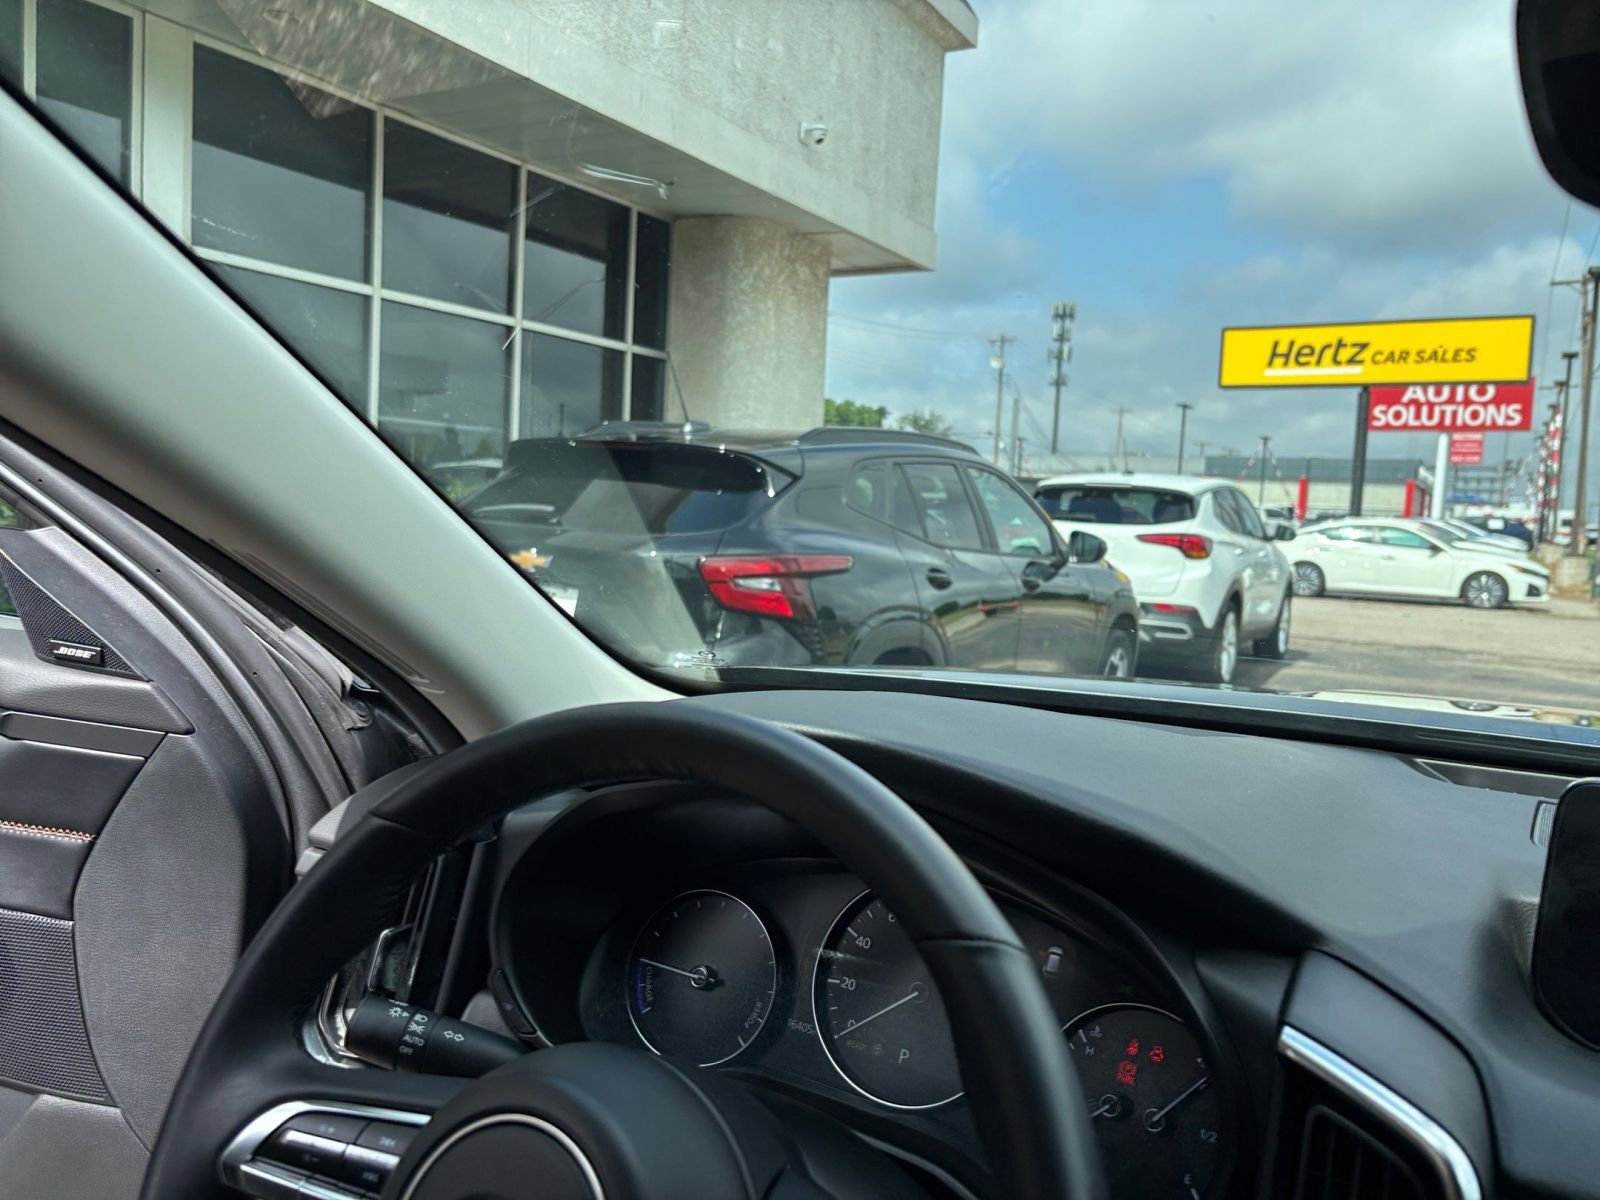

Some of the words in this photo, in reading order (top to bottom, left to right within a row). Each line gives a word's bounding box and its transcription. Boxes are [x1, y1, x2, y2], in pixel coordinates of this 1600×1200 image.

[1267, 337, 1371, 367] Hertz
[1371, 349, 1411, 365] CAR
[1414, 347, 1477, 364] SALES
[1401, 384, 1496, 403] AUTO
[1371, 403, 1523, 427] SOLUTIONS
[53, 646, 97, 659] BOSE
[856, 936, 871, 950] 40
[840, 977, 856, 991] 20
[402, 1034, 424, 1046] AUTO
[898, 1048, 910, 1065] P
